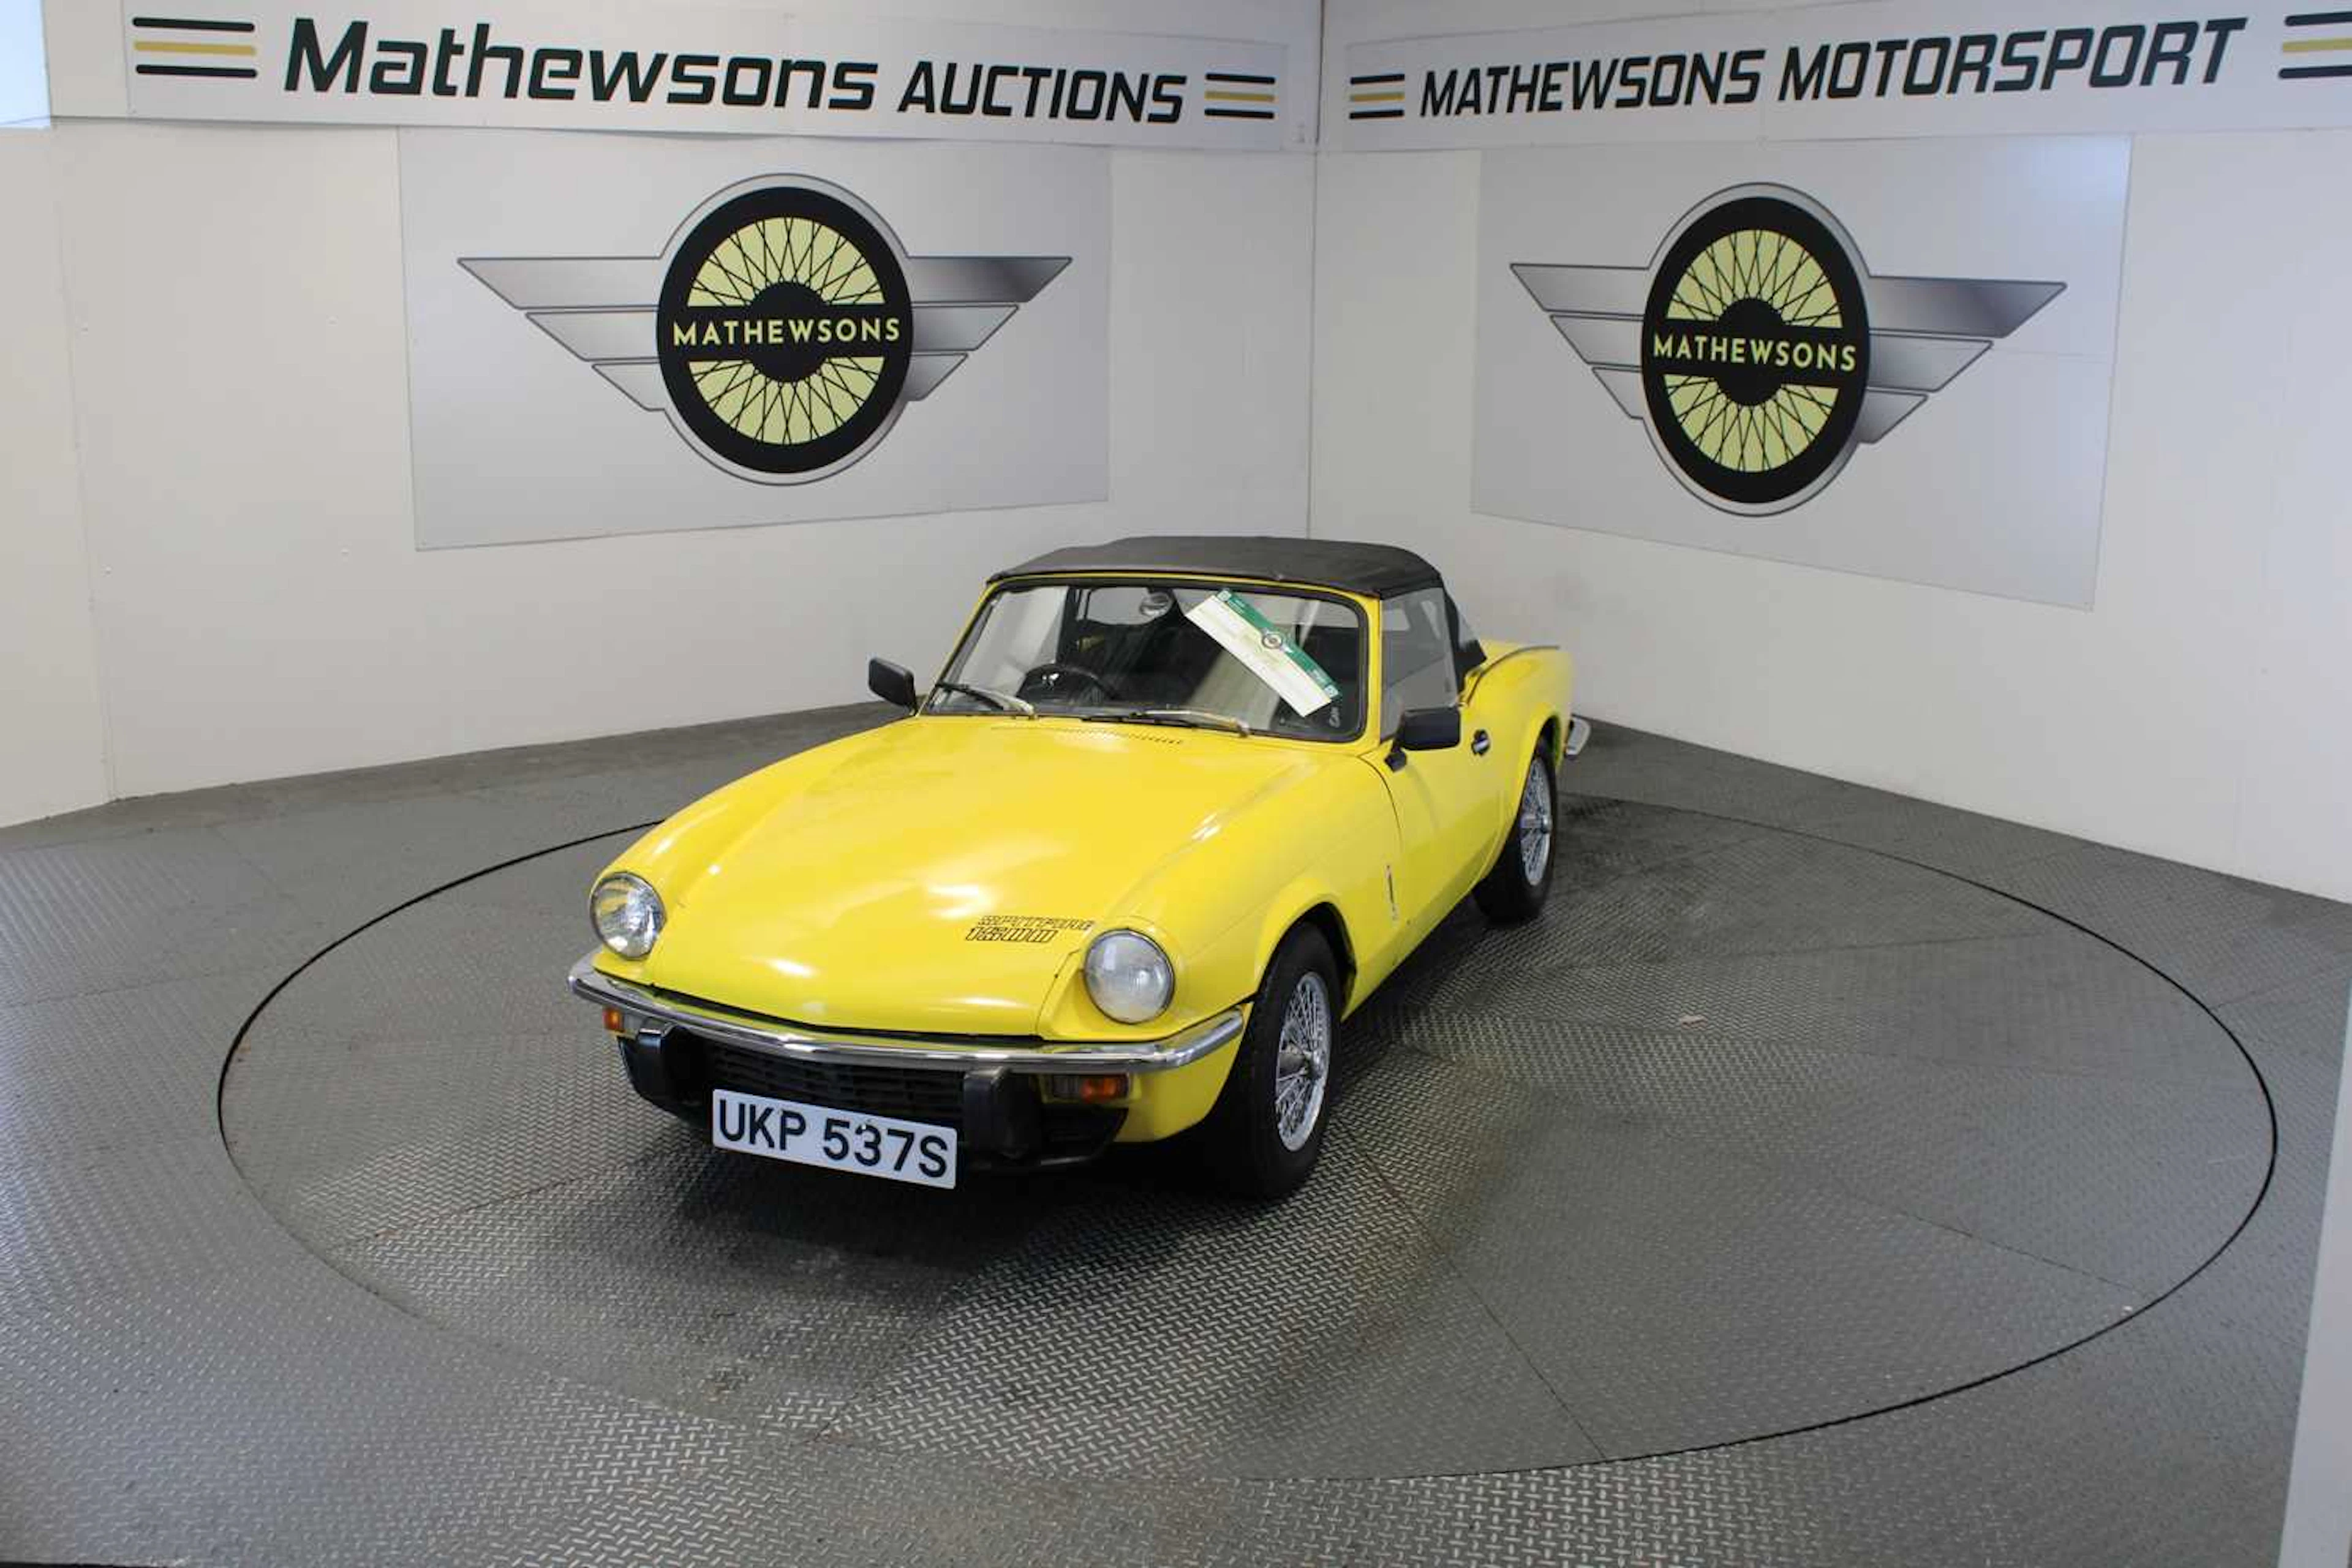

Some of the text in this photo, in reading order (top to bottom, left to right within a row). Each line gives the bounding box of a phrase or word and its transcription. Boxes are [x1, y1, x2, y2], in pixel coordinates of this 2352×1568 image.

[284, 18, 1188, 125] Mathewsons AUCTIONS
[1419, 17, 2248, 119] MATHEWSONS MOTORSPORT
[673, 317, 900, 346] MATHEWSONS
[1654, 334, 1856, 371] MATHEWSONS
[719, 1098, 948, 1178] UKP 537S
